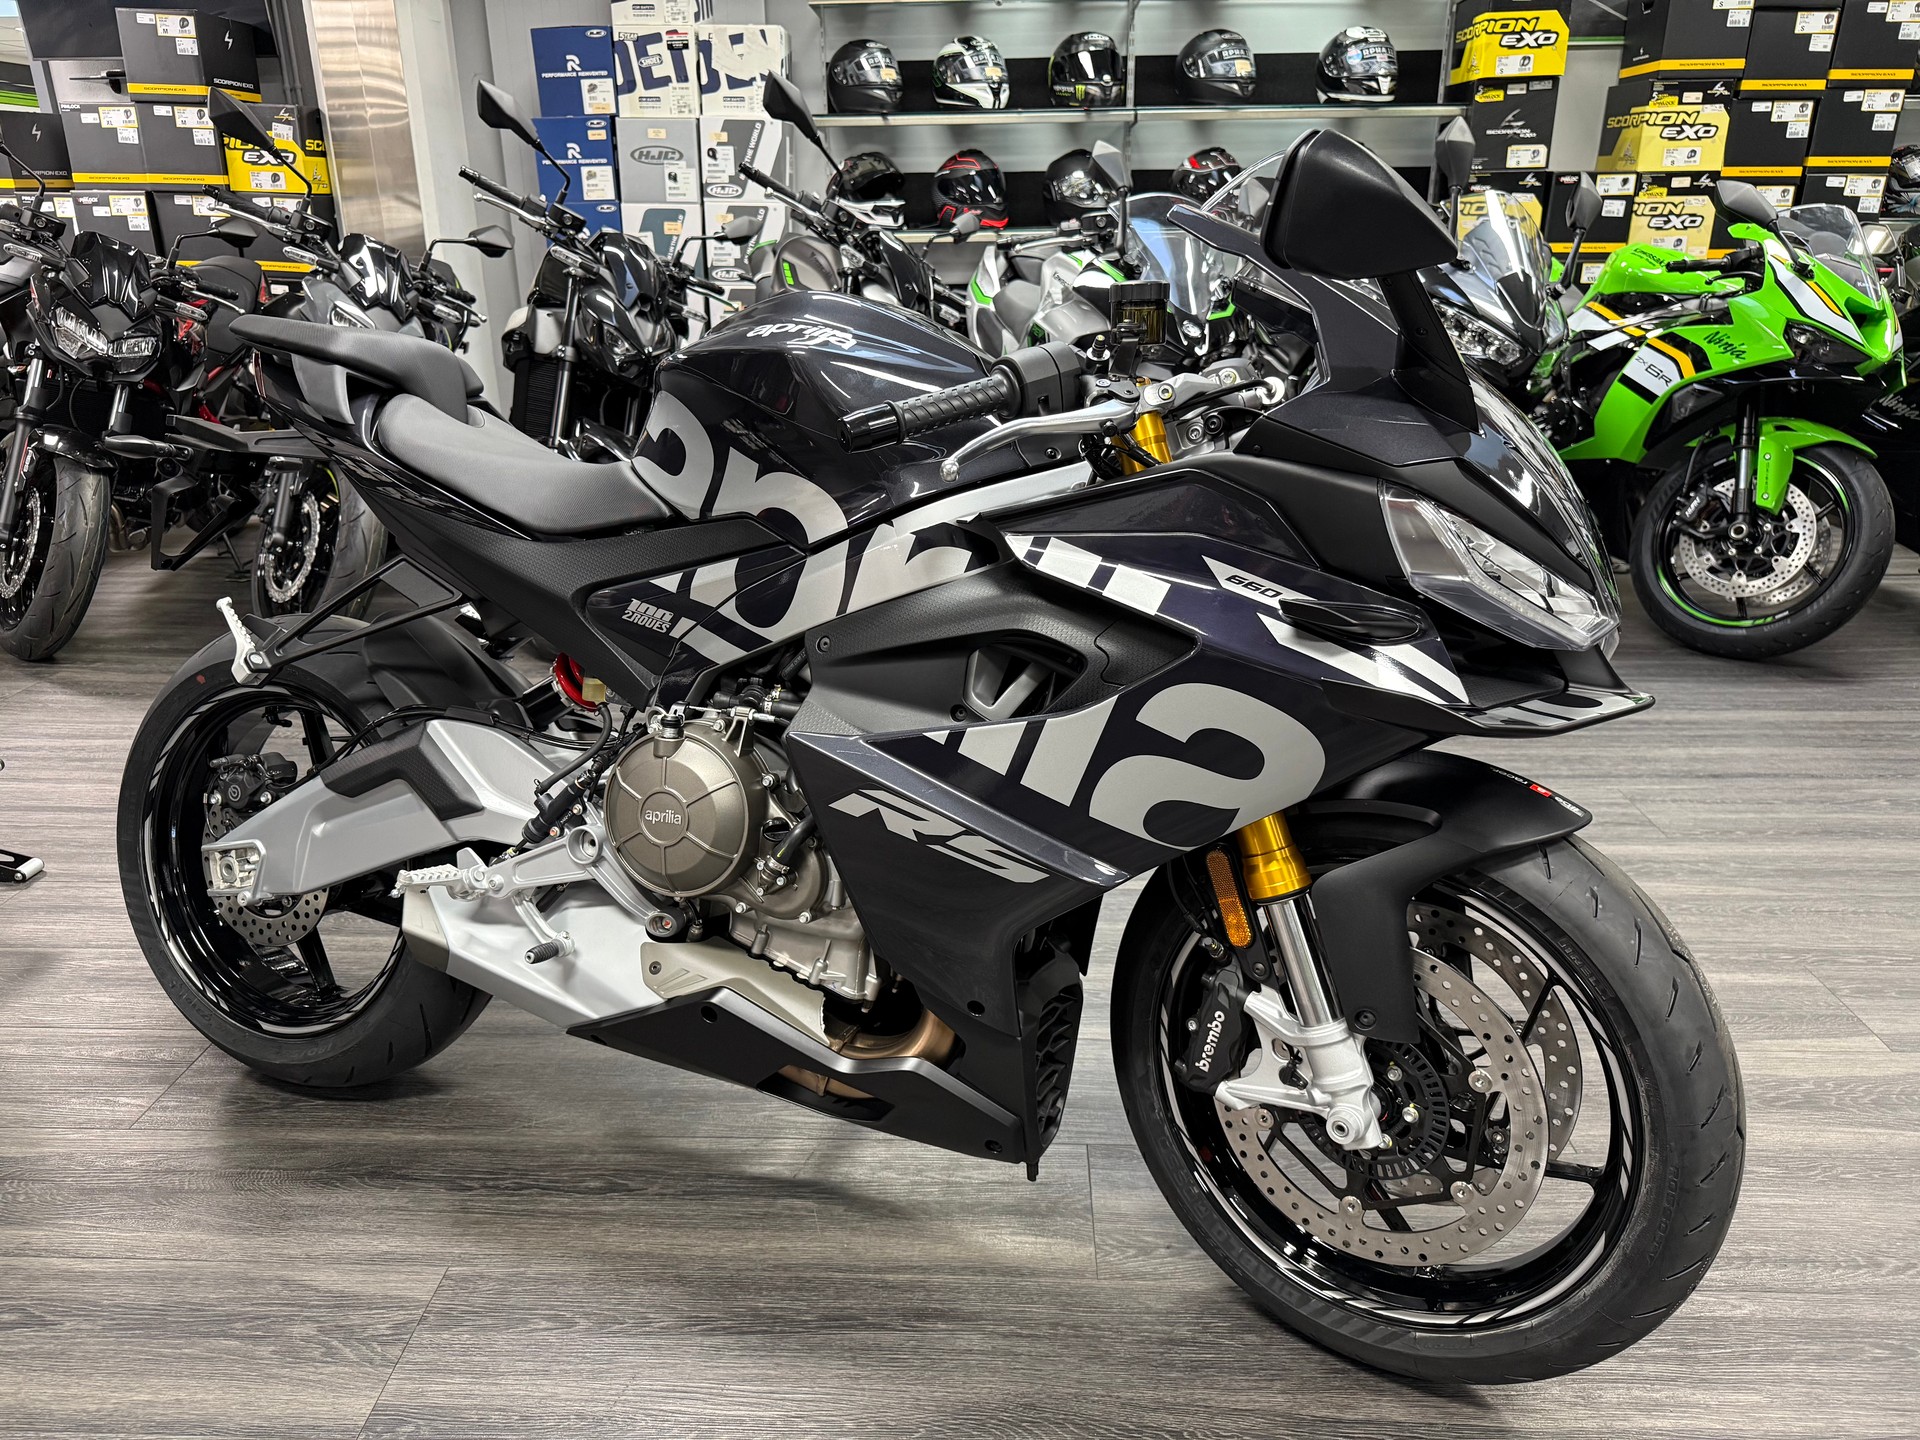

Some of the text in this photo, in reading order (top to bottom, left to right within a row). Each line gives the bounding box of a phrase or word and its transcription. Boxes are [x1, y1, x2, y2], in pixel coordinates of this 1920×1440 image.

[1455, 16, 1541, 44] SCORPION
[1499, 30, 1559, 49] EXO
[213, 78, 241, 87] SCORPION
[1606, 111, 1700, 129] SCORPION
[1659, 123, 1719, 140] EXO
[749, 122, 762, 149] WORLD
[637, 150, 675, 161] HJC
[711, 187, 738, 195] HJC
[1648, 214, 1704, 230] EXO
[746, 322, 857, 351] aprilia
[1702, 329, 1747, 361] Ninja
[1879, 393, 1920, 420] Ninja
[1224, 572, 1284, 600] 660
[621, 610, 672, 634] 2ROUES
[644, 809, 682, 826] aprilia
[827, 788, 1050, 885] RS
[1195, 1009, 1226, 1074] brembo
